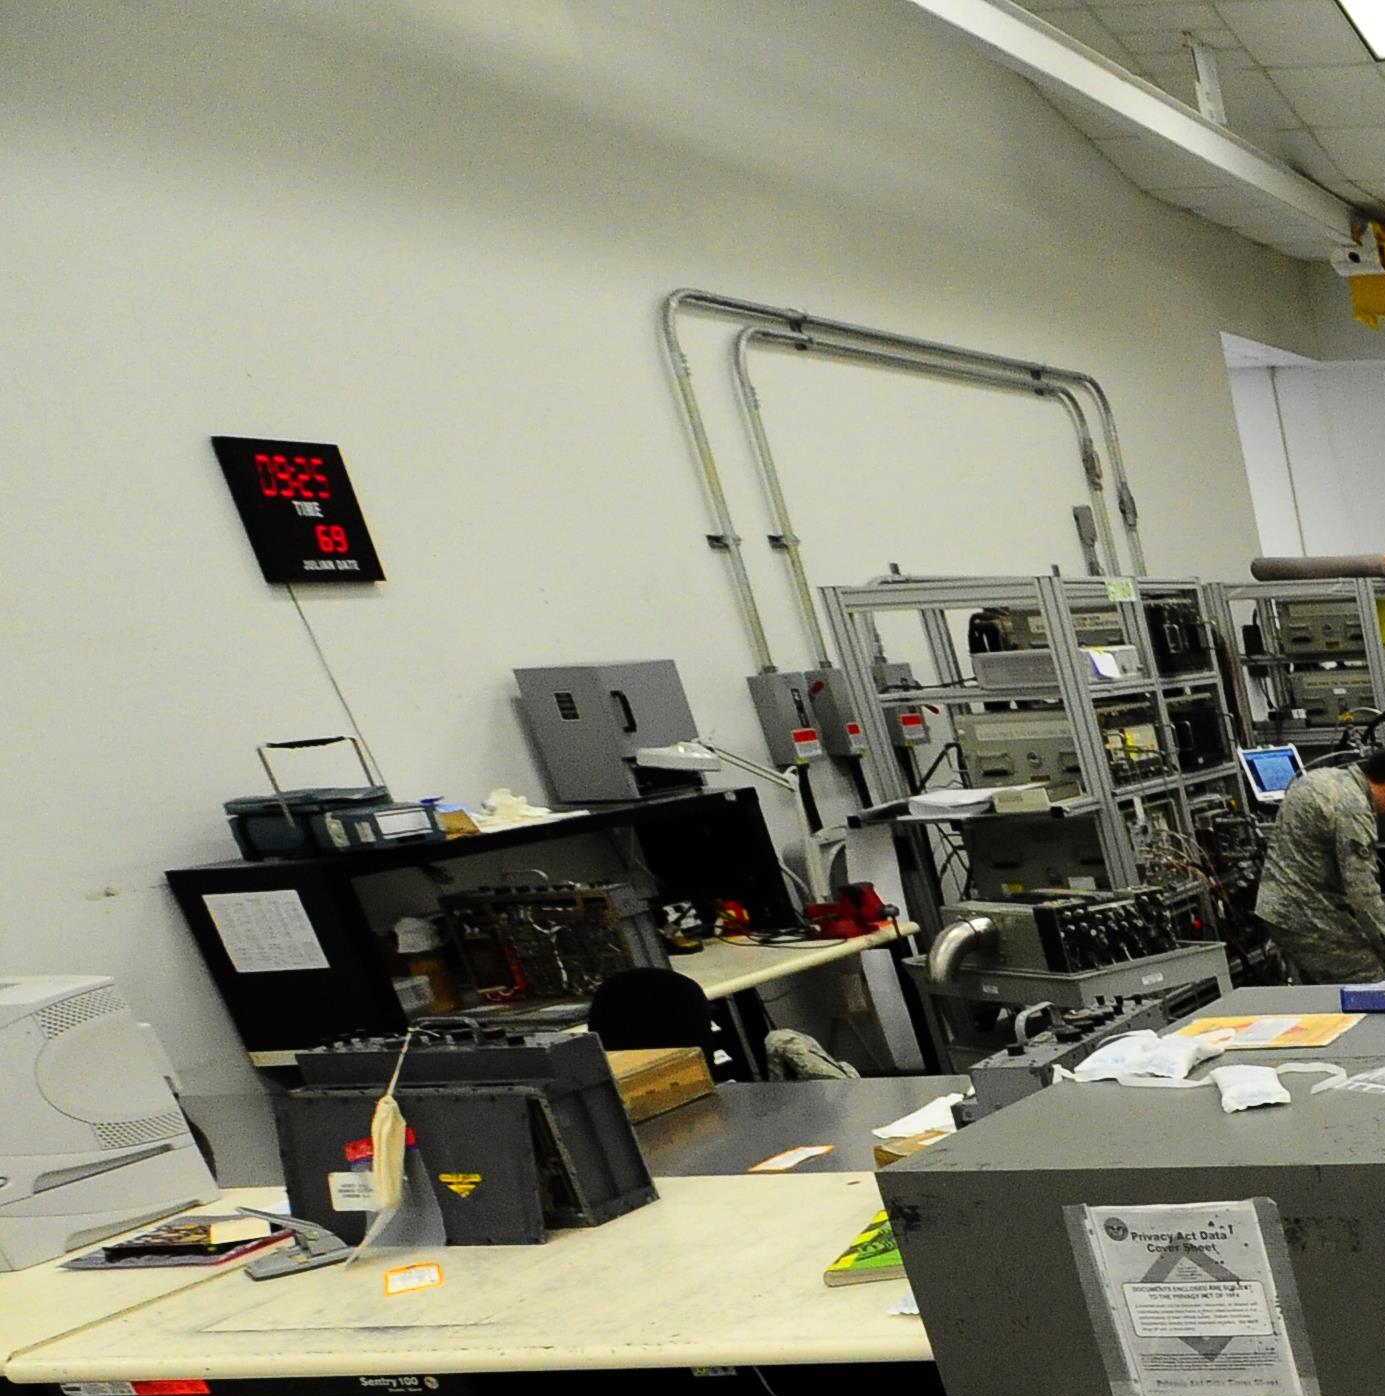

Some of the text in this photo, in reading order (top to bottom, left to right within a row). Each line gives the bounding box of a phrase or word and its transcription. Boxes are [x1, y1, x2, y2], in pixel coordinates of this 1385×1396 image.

[292, 500, 324, 518] TIME
[315, 523, 348, 554] 69
[1130, 1230, 1228, 1244] Privacy Act Data
[1146, 1242, 1217, 1253] Cover Sheet
[359, 1376, 419, 1388] Sentry 100
